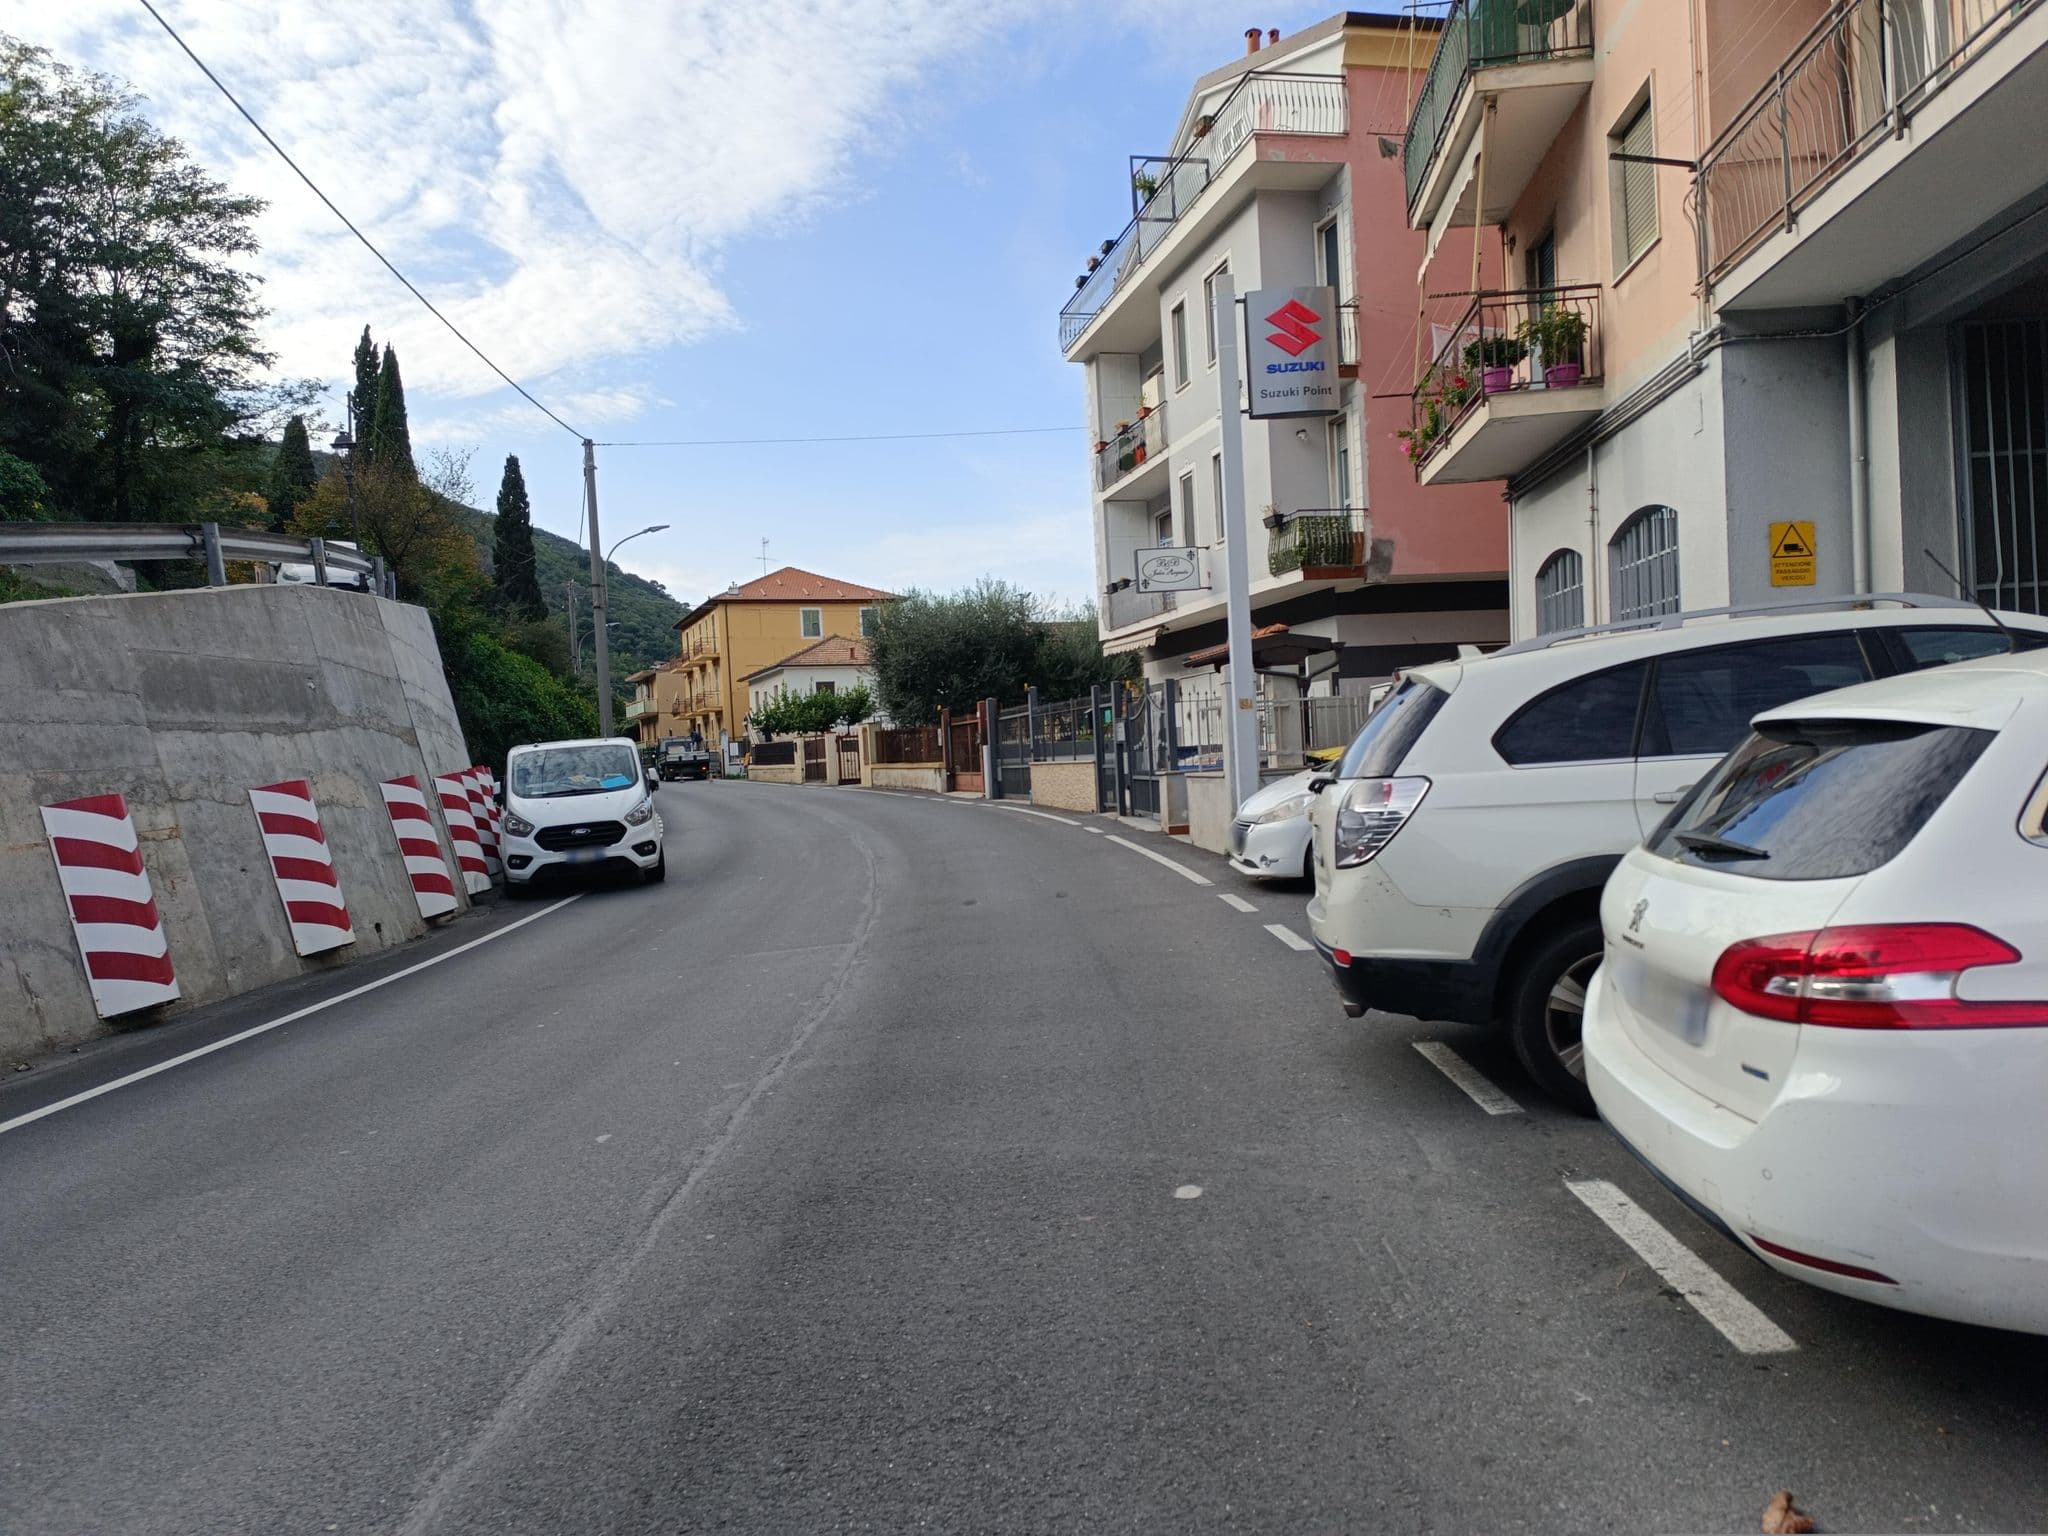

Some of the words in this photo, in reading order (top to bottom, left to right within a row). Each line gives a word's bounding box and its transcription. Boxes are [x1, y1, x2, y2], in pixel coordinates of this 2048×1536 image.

[1266, 361, 1325, 374] SUZUKI
[1260, 387, 1299, 399] Suzuki
[1303, 386, 1332, 396] Point
